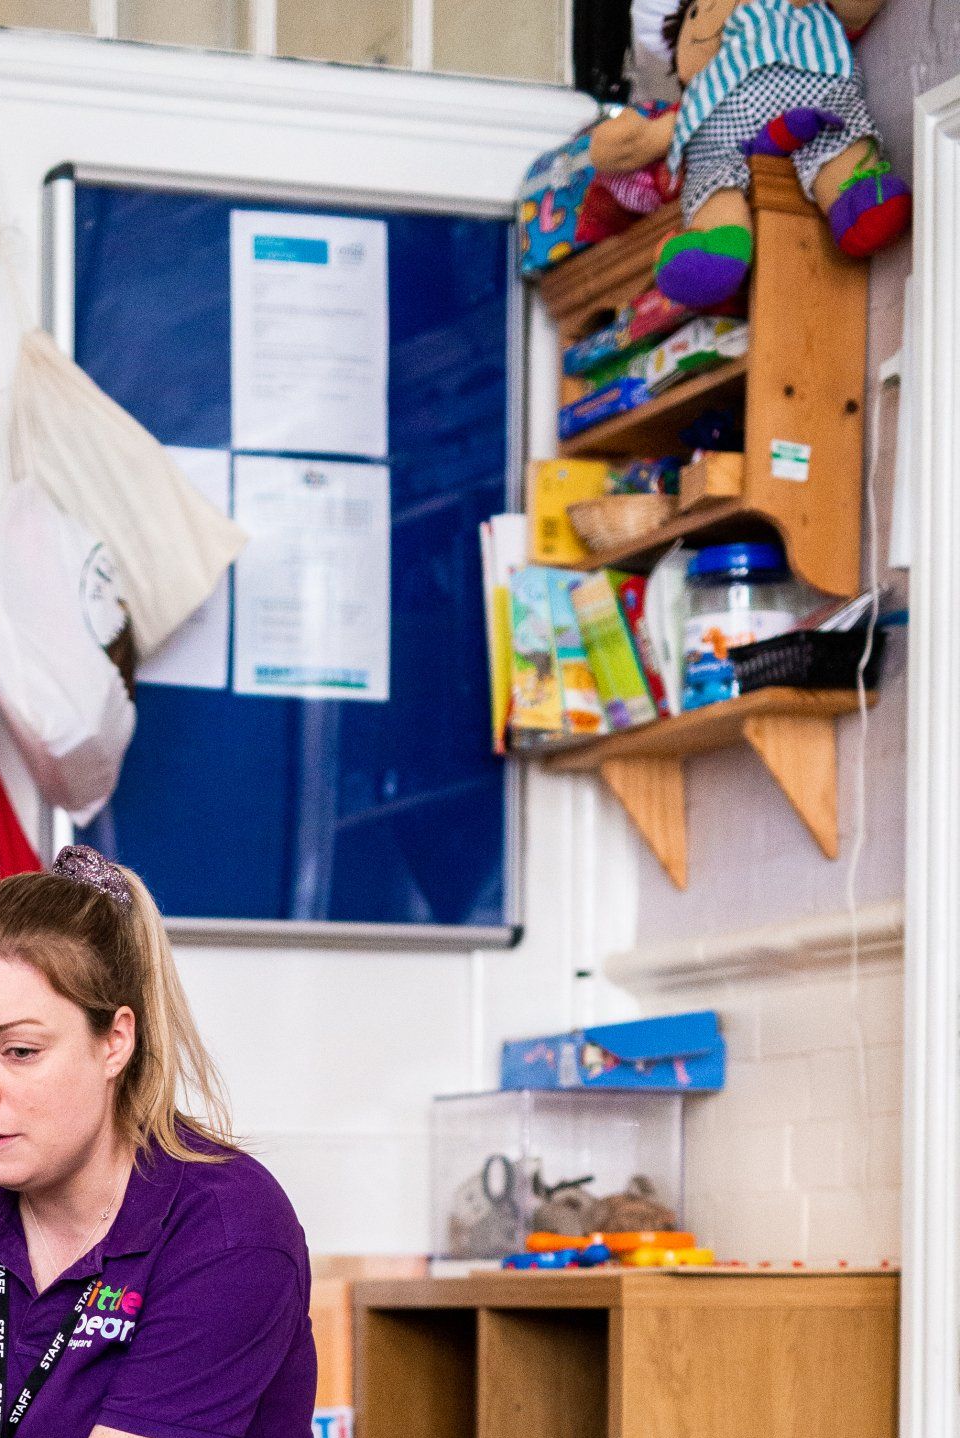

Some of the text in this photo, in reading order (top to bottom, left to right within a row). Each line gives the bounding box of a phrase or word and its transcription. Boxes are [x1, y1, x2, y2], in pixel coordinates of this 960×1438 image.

[86, 1281, 143, 1315] ittle
[40, 1332, 66, 1370] STAFF
[68, 1338, 93, 1350] aycare
[9, 1388, 32, 1423] STAFF
